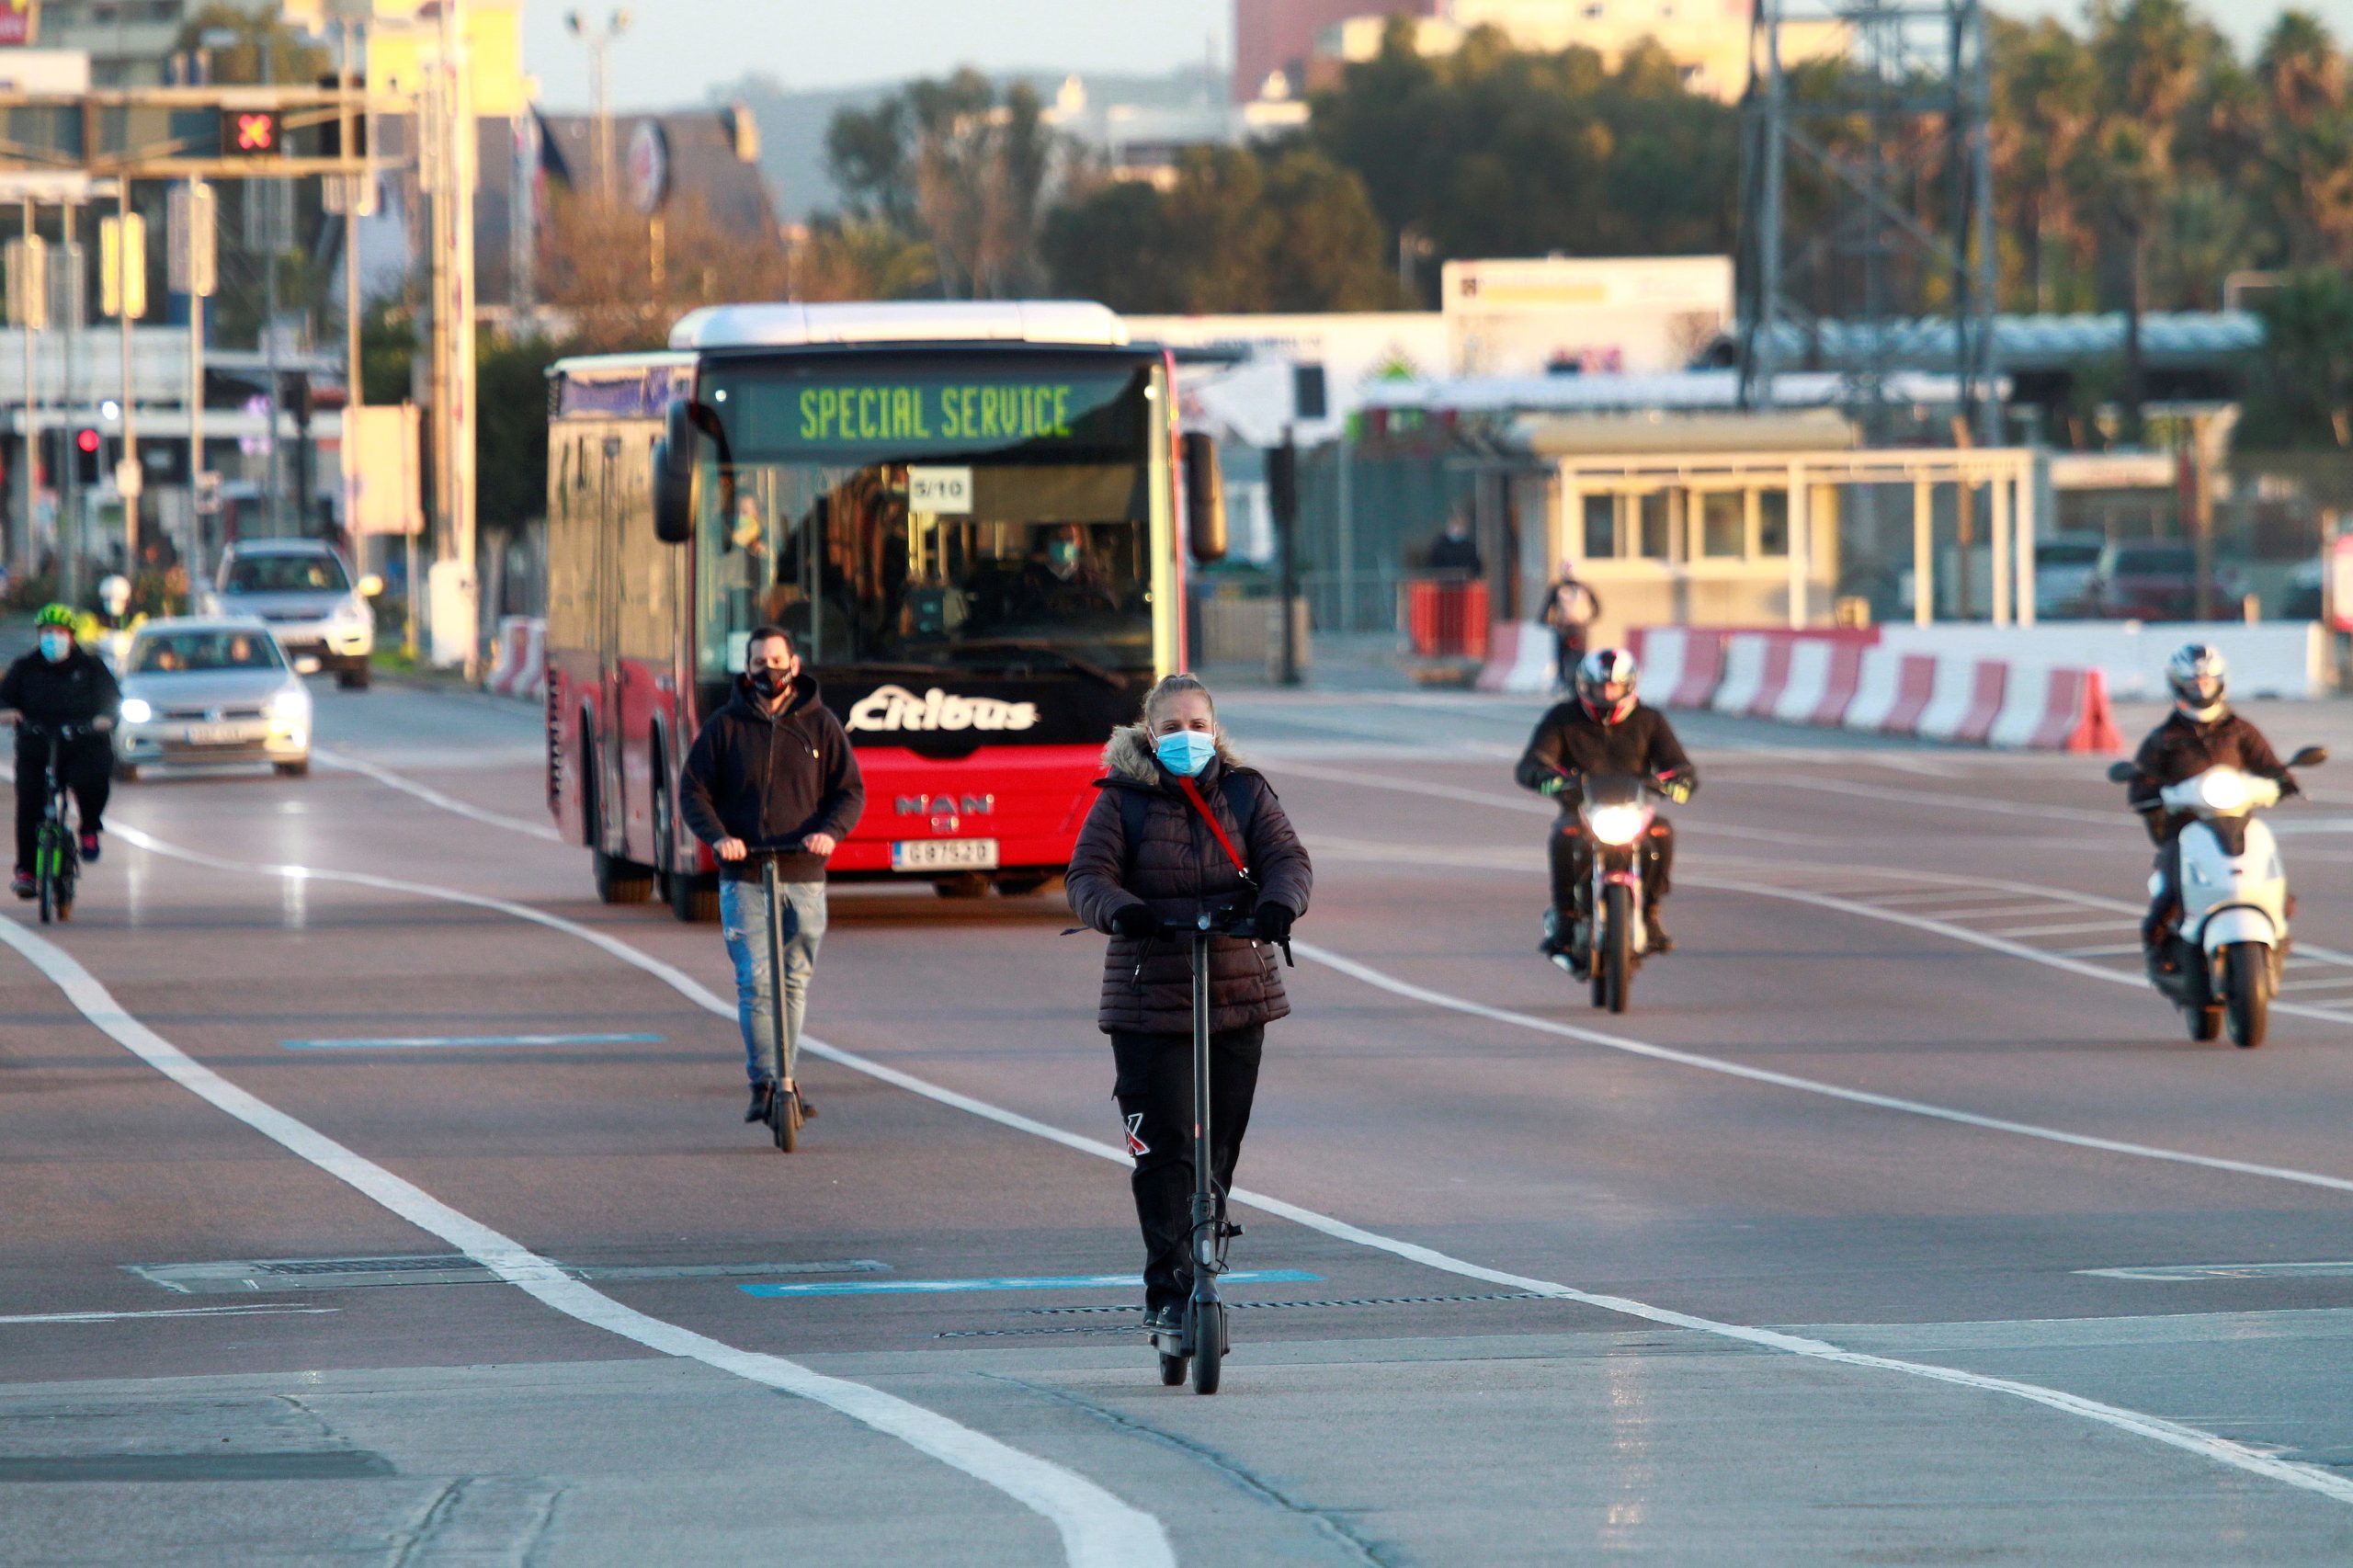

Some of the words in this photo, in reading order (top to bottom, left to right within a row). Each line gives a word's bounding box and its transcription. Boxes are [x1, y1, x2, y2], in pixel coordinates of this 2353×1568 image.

[800, 387, 931, 440] SPECIAL
[940, 384, 1074, 437] SERVICE
[895, 794, 995, 816] MAN
